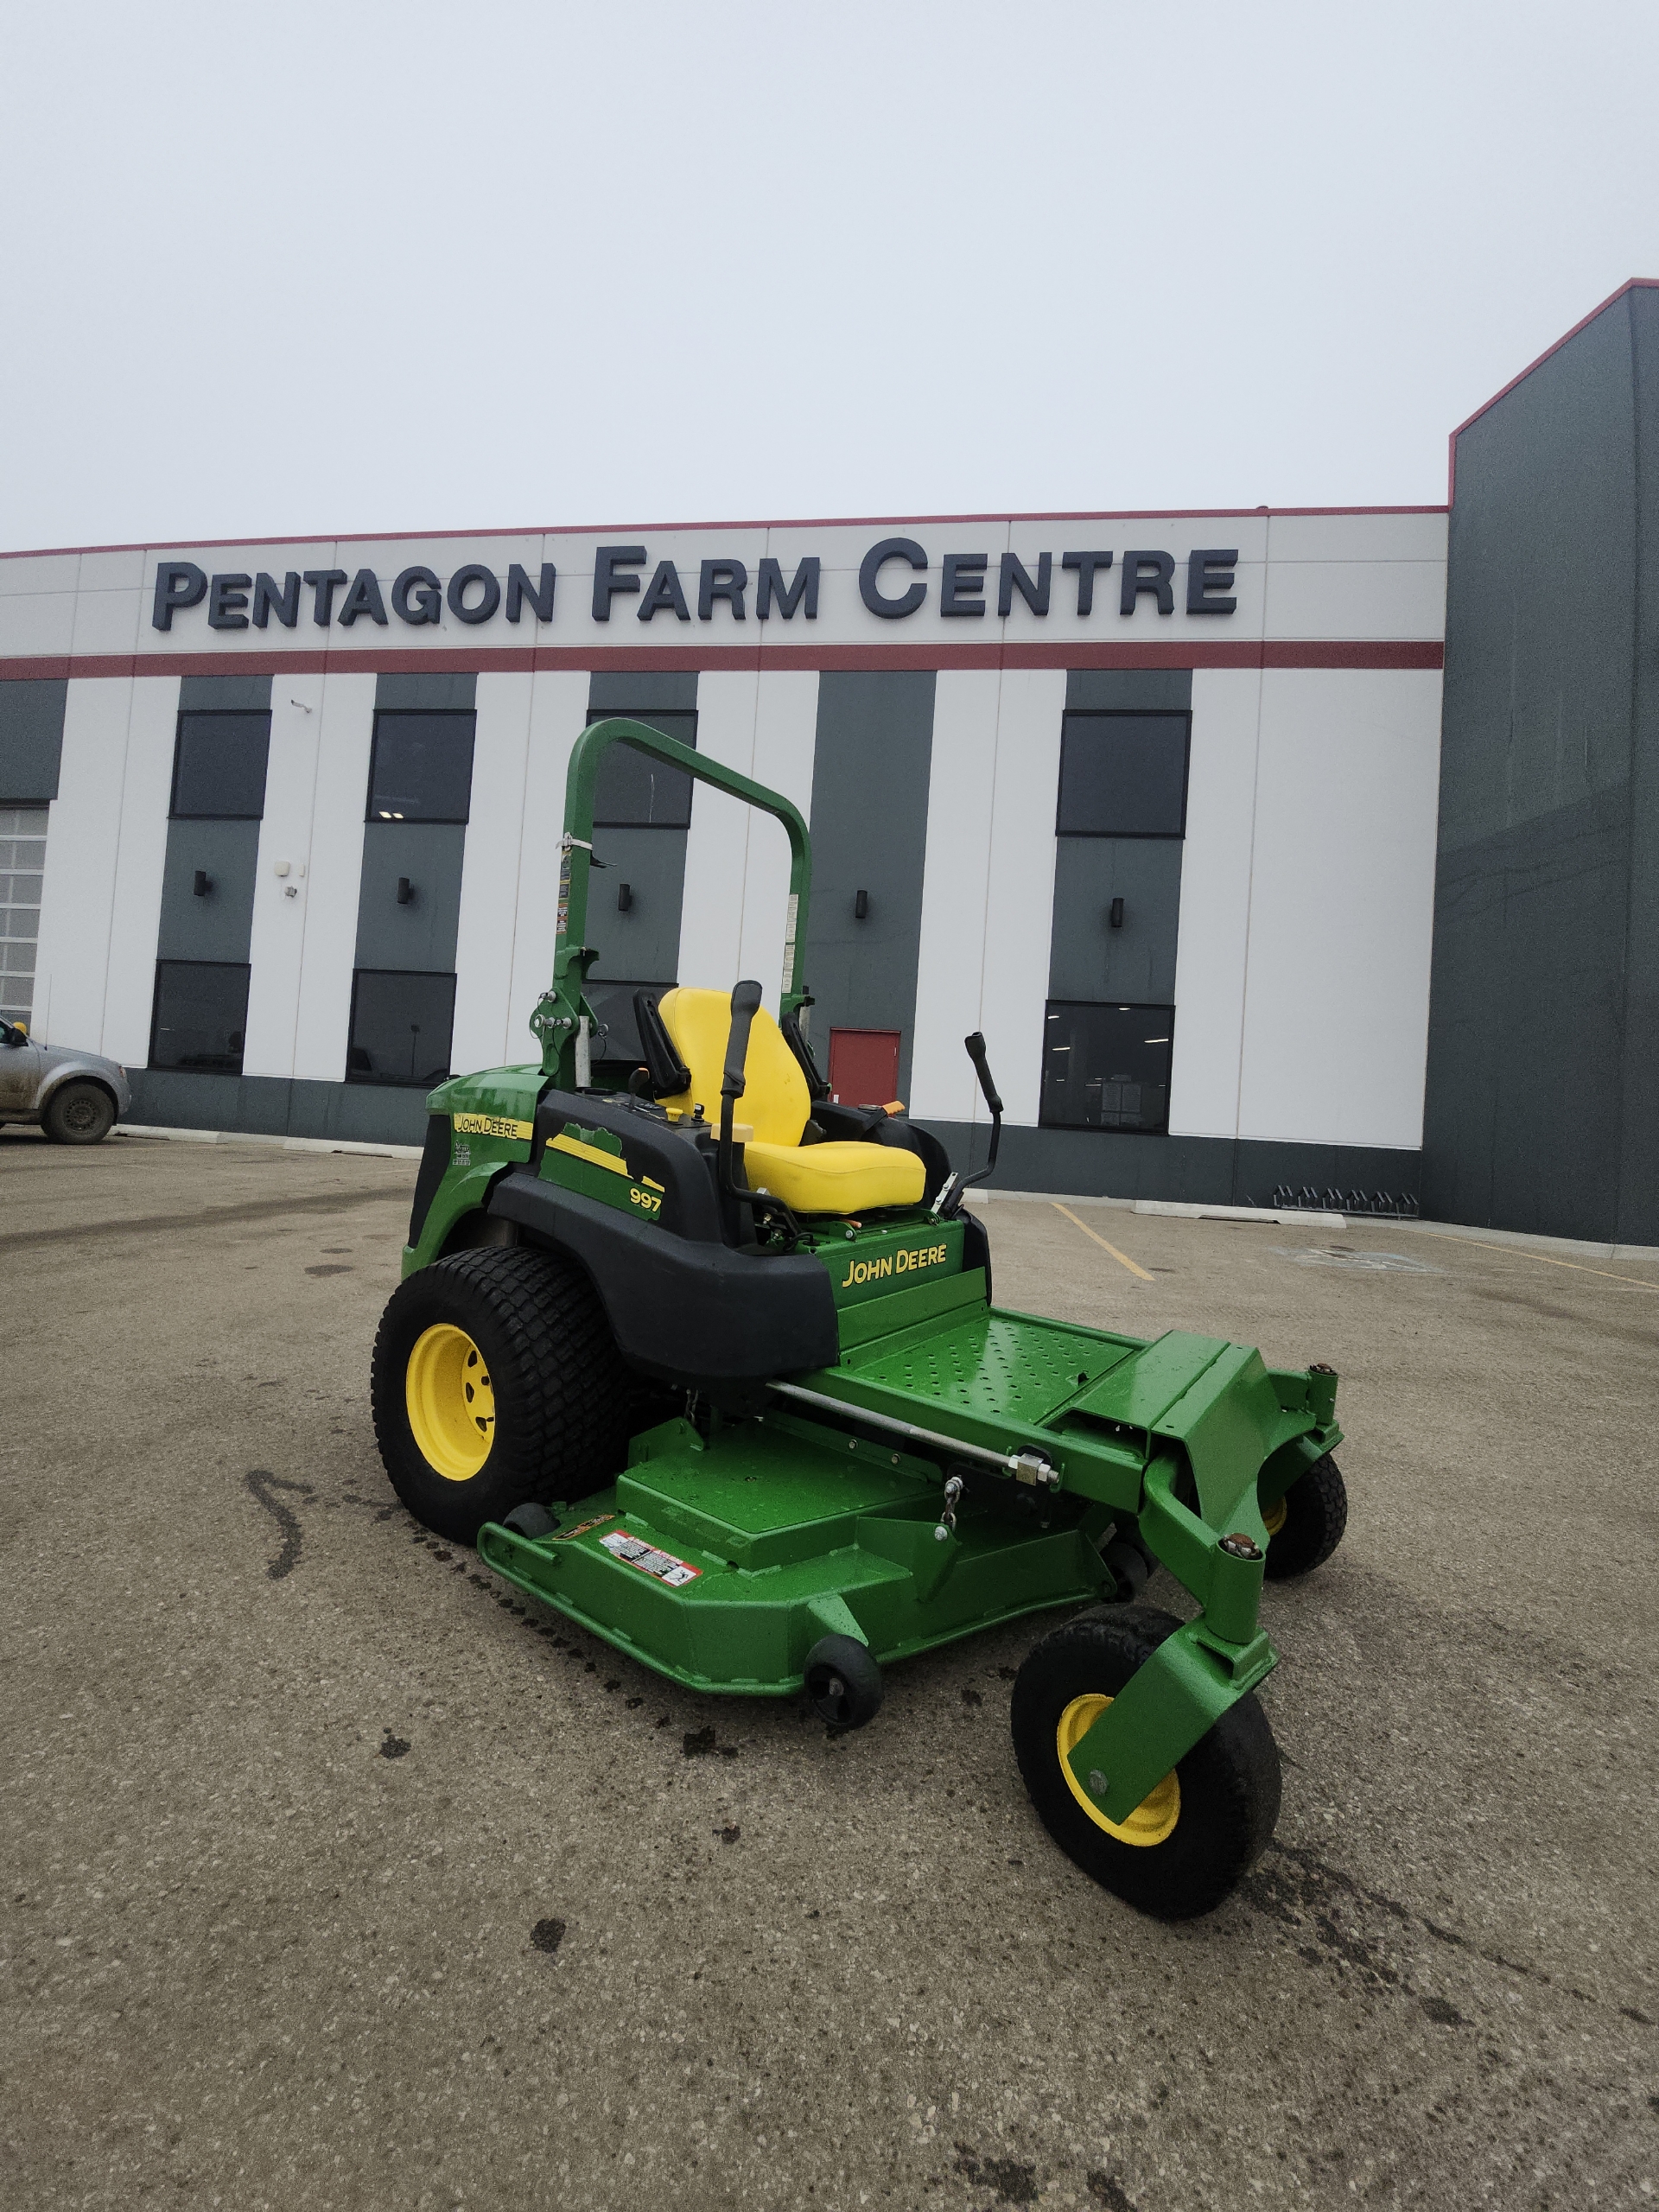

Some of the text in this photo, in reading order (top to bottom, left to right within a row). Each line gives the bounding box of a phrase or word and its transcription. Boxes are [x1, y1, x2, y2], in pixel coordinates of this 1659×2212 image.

[152, 537, 1238, 632] PENTAGON FARM CENTRE
[458, 1116, 518, 1137] JOHN DEERE
[629, 1187, 662, 1212] 997
[842, 1243, 947, 1287] JOHN DEERE
